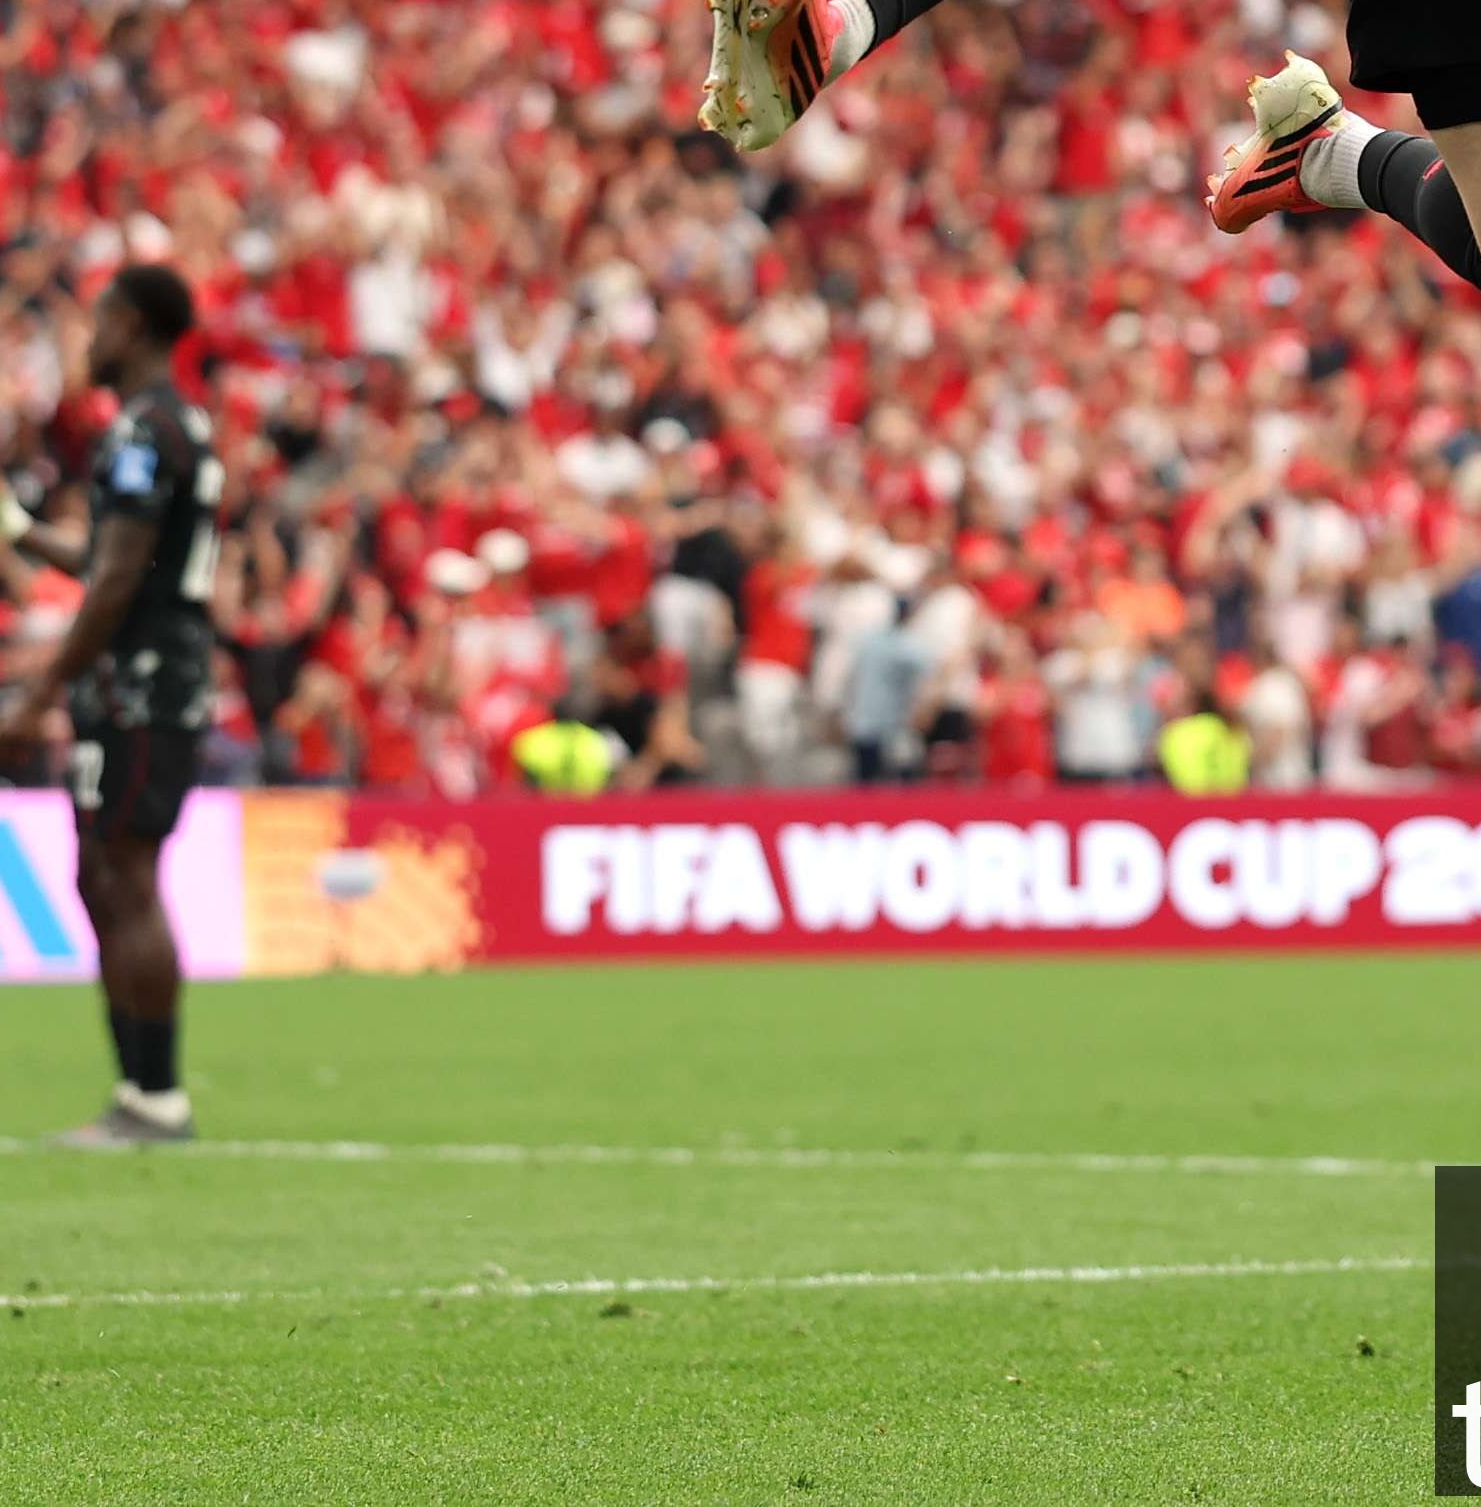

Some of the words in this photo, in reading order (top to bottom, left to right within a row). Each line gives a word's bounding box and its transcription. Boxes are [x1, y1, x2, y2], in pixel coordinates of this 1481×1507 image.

[541, 824, 783, 935] FIFA
[777, 819, 1166, 933] WORLD
[1166, 817, 1382, 929] CUP
